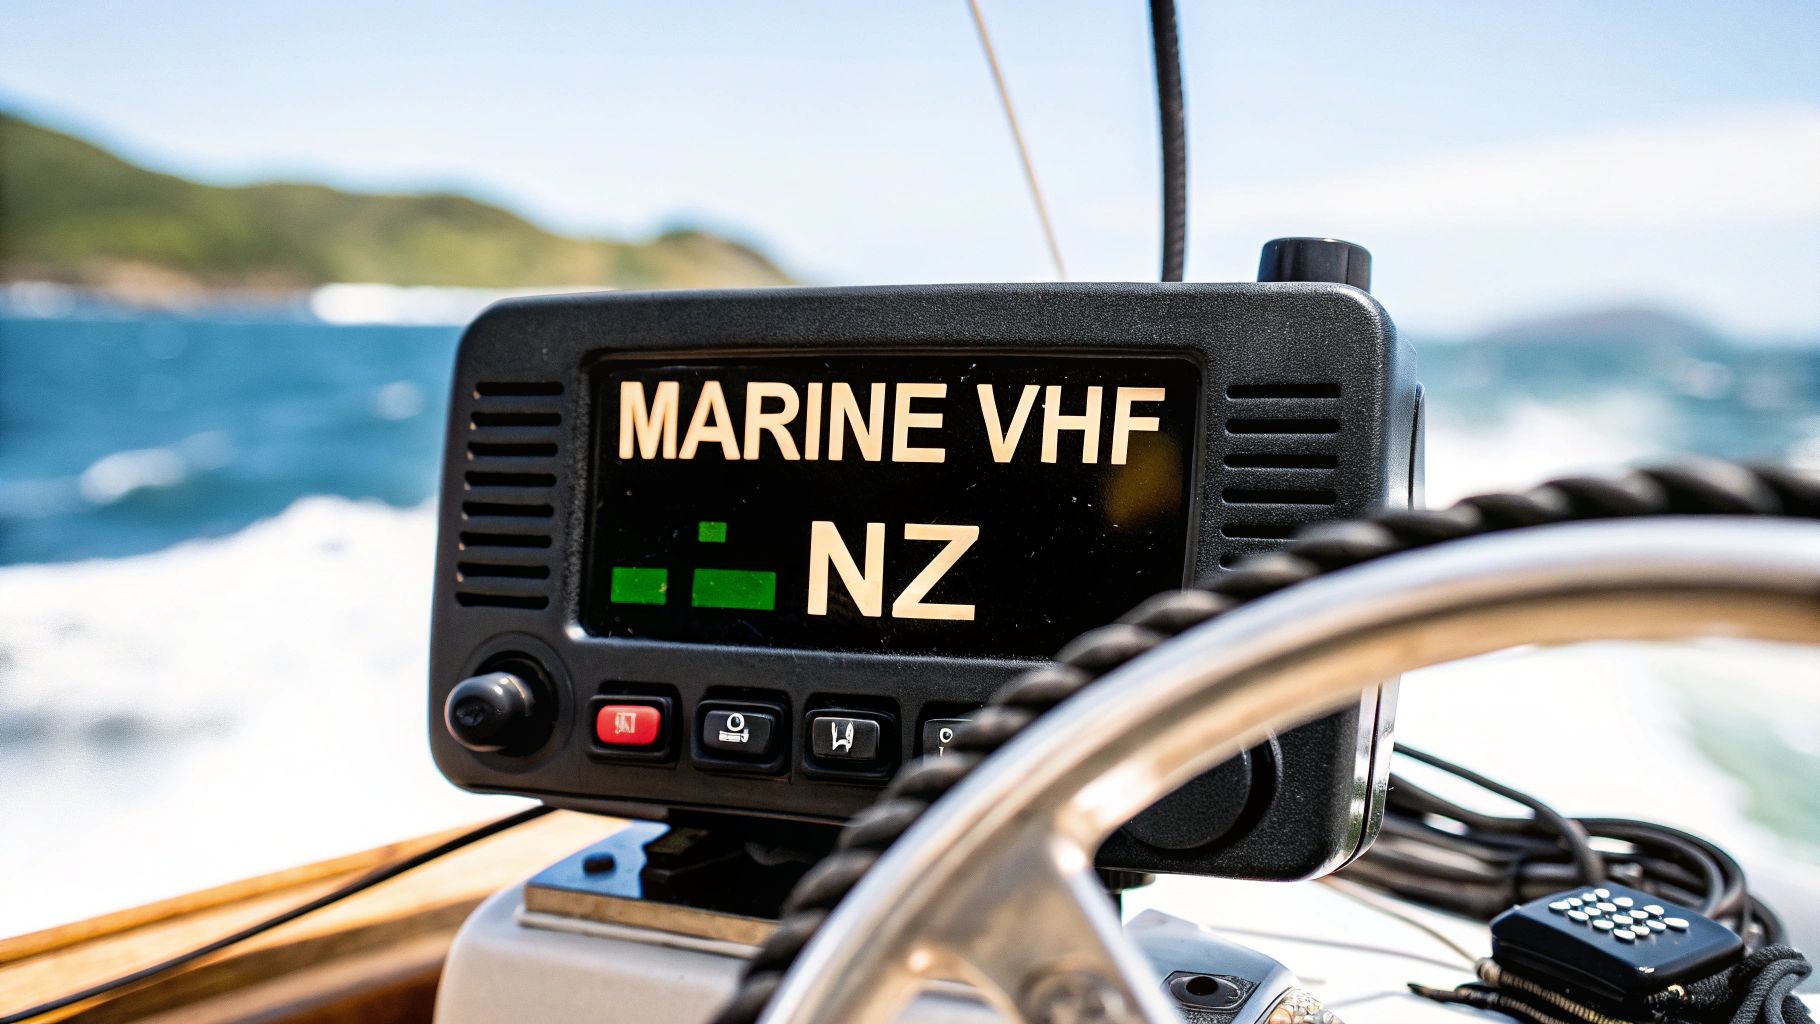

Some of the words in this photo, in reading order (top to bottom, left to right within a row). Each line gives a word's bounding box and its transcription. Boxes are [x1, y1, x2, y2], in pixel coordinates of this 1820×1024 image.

[618, 380, 948, 464] MARINE
[976, 383, 1166, 466] VHF
[806, 520, 980, 621] NZ
